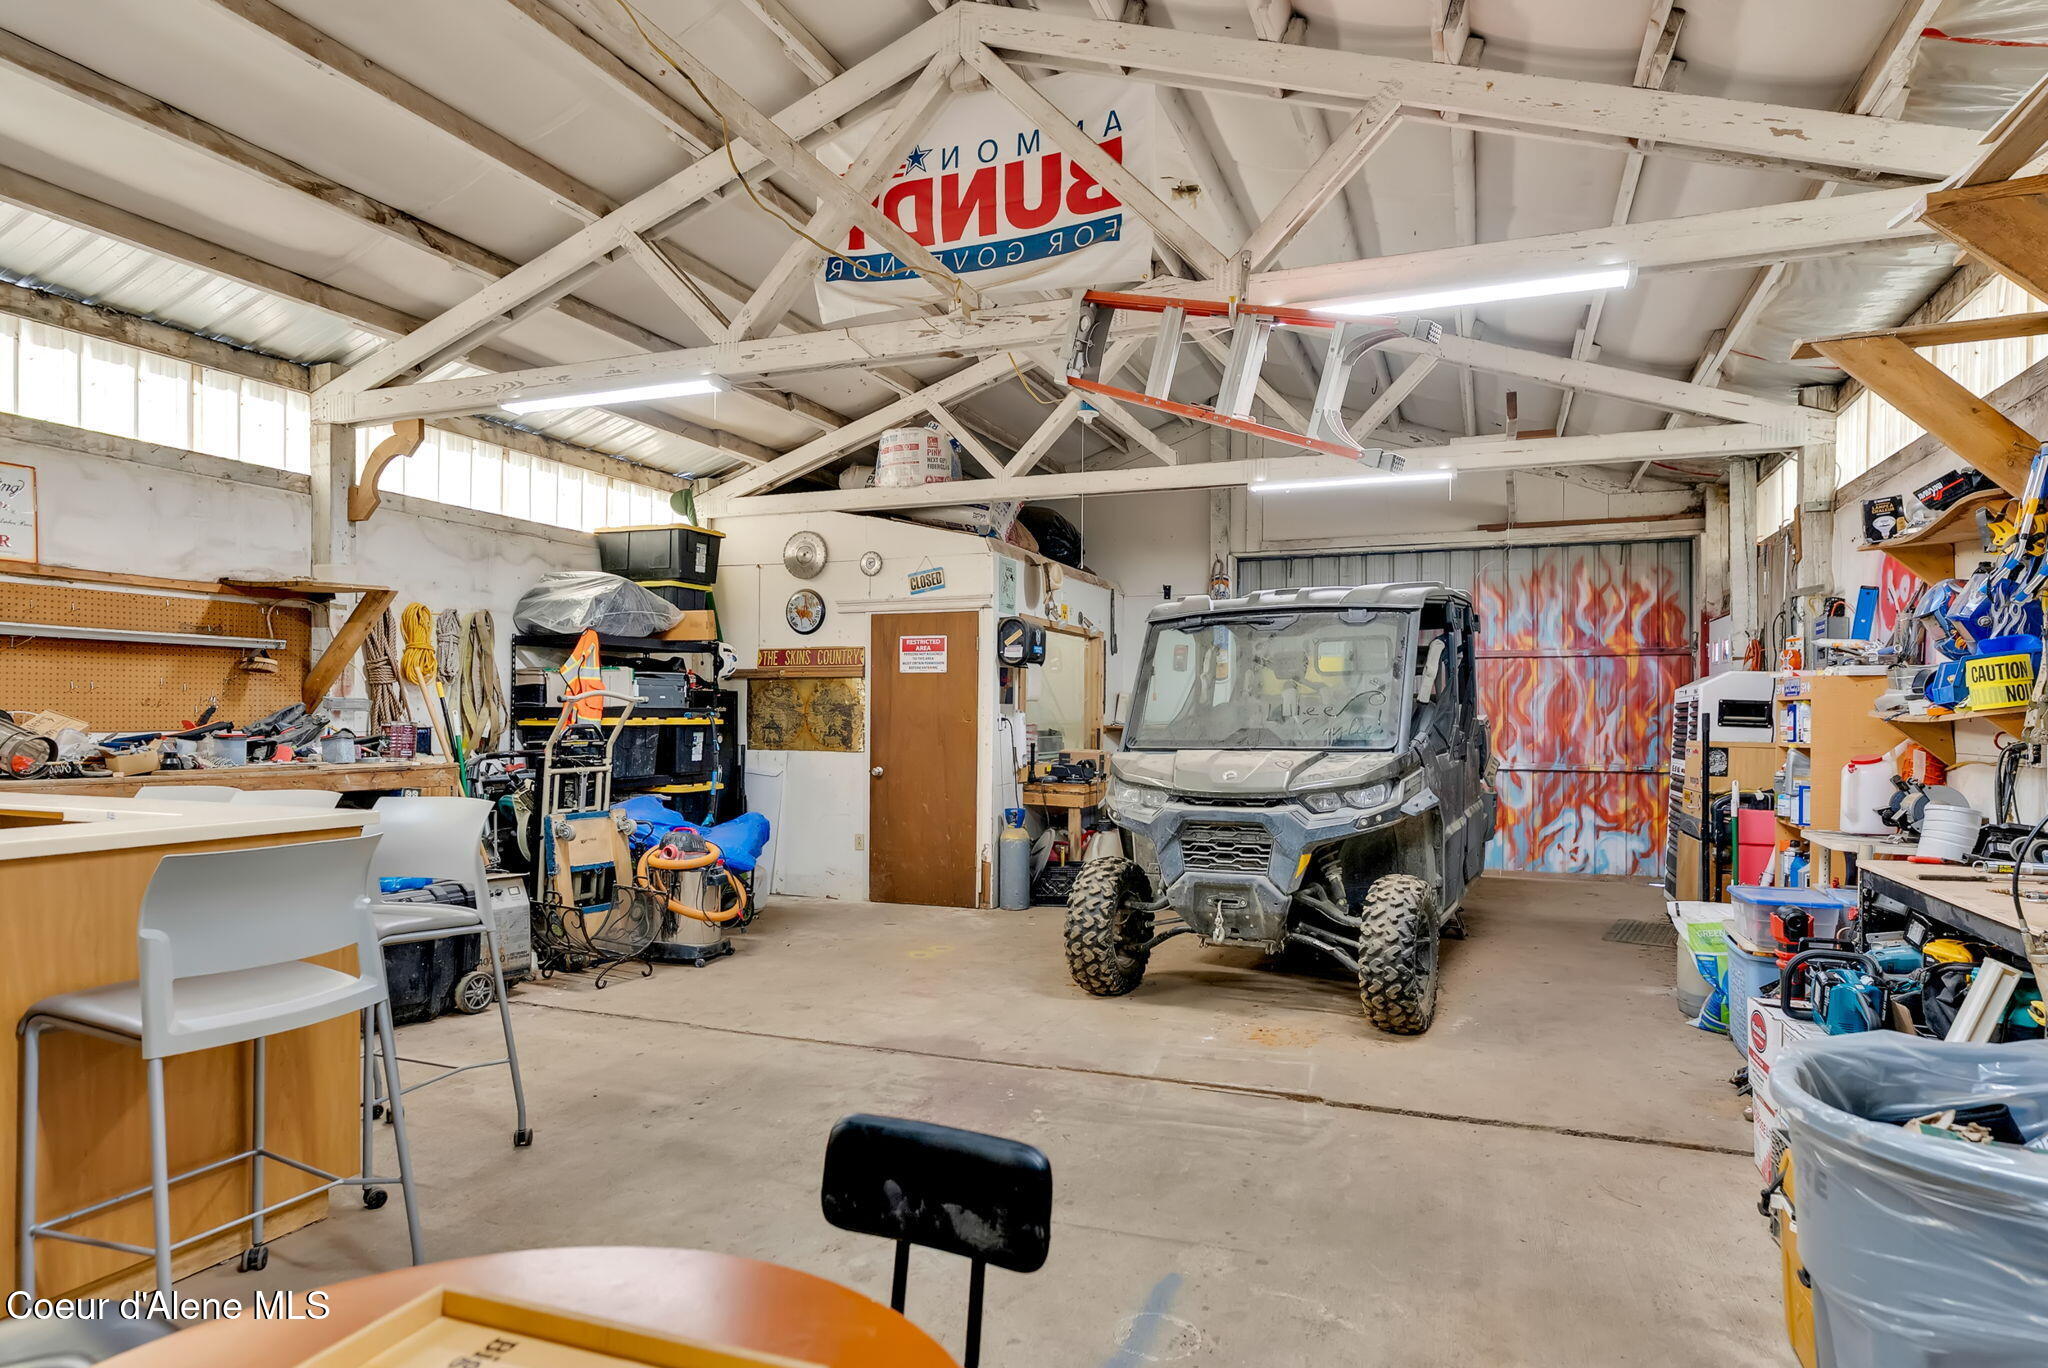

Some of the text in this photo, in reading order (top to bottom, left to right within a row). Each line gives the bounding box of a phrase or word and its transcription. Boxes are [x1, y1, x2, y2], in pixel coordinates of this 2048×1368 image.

[926, 449, 942, 457] PINK
[910, 571, 943, 590] CLOSED
[763, 648, 861, 666] THE SKINS COUNTRY
[1971, 661, 2029, 683] CAUTION
